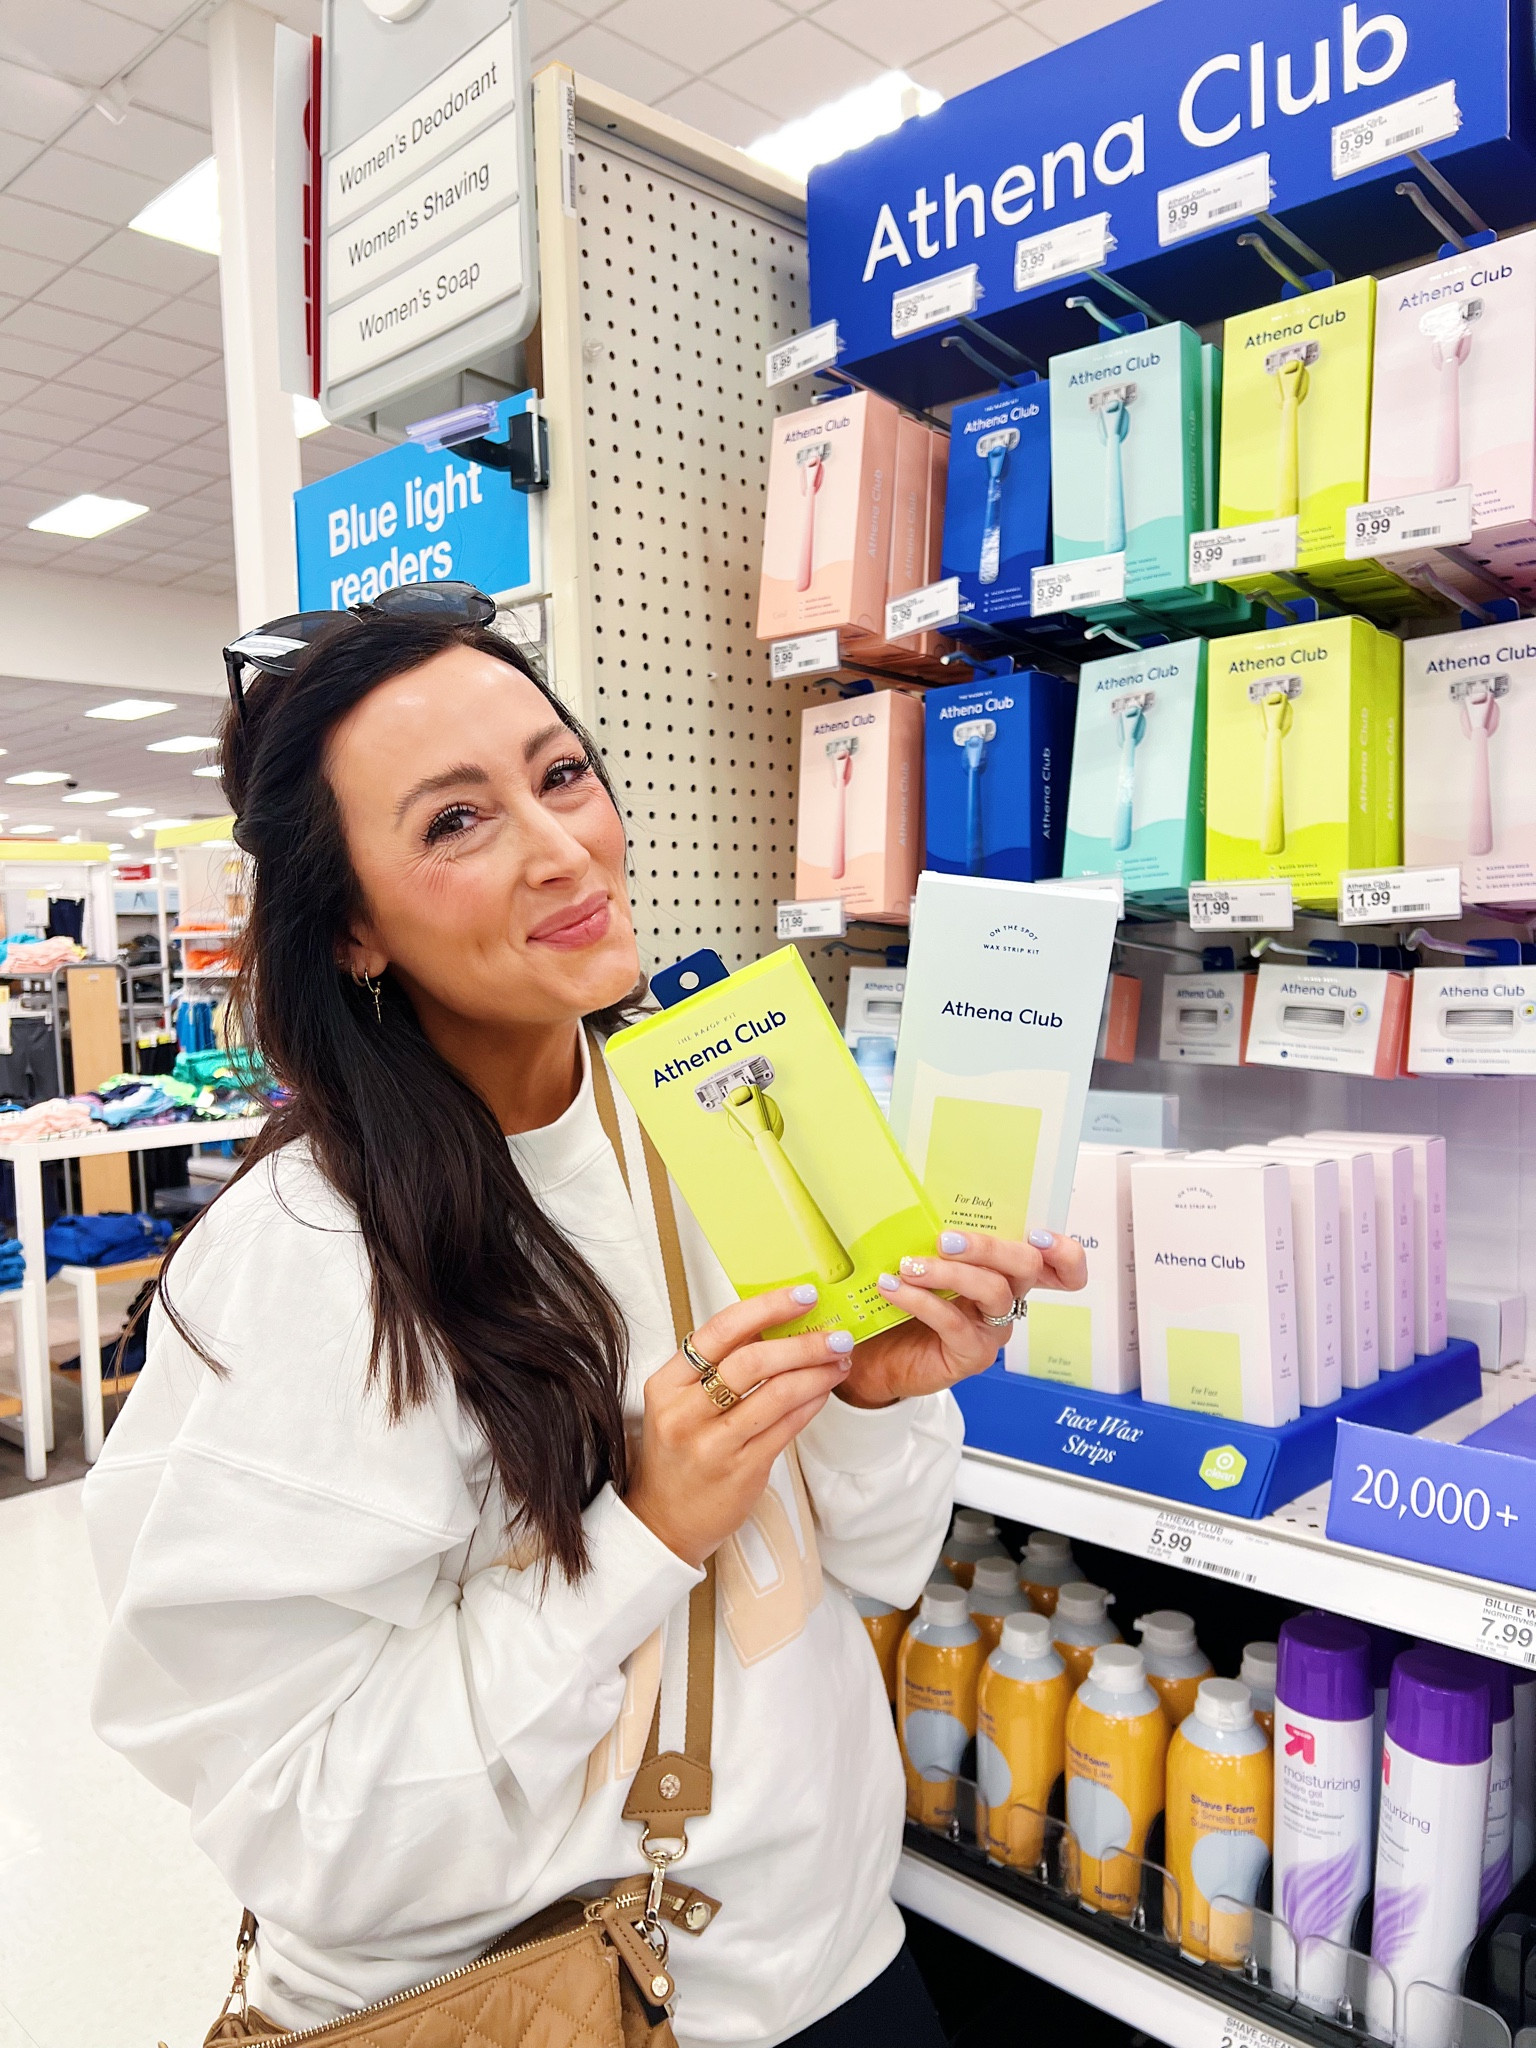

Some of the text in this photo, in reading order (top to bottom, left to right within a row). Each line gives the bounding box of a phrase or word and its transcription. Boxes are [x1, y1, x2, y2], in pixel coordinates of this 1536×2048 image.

[339, 133, 407, 194] Women's
[412, 61, 498, 144] Deodorant
[862, 2, 1408, 283] Athena Club
[1339, 130, 1374, 154] 9.99
[348, 162, 490, 268] Women's Shaving
[1168, 202, 1198, 224] 9.99
[358, 261, 480, 342] Women's Soap
[1399, 265, 1513, 311] Athena Club
[1244, 321, 1303, 349] Athena
[1308, 309, 1346, 331] Club
[1068, 365, 1122, 388] Athena
[1126, 352, 1161, 373] Club
[784, 417, 850, 444] Athena Club
[963, 413, 1009, 435] Athena
[1009, 403, 1040, 421] Club
[328, 461, 483, 558] Blue light
[868, 468, 884, 558] Athena Club
[1356, 518, 1391, 537] 9.99
[1193, 546, 1223, 564] 9.99
[330, 540, 453, 611] readers
[1037, 585, 1063, 601] 9.99
[1228, 647, 1329, 675] Athena Club
[1426, 644, 1536, 674] Athena Club
[1095, 664, 1180, 692] Athena Club
[939, 695, 1014, 720] Athena Club
[813, 713, 876, 735] Athena Club
[1360, 707, 1369, 814] Athena Club
[1041, 747, 1052, 840] Athena Club
[1193, 901, 1230, 916] 11.99
[1347, 891, 1391, 908] 11.99
[781, 916, 803, 929] 11.99
[989, 927, 1001, 937] ON
[1020, 927, 1038, 941] SPOT
[1176, 987, 1225, 999] Athena Club
[1280, 983, 1357, 998] Athena Club
[1439, 983, 1525, 998] Athena Club
[941, 1000, 1063, 1028] Athena Club
[654, 1038, 732, 1088] Athena
[734, 1011, 787, 1043] Club
[955, 1194, 994, 1209] For Body
[1154, 1252, 1246, 1270] Athena Club
[858, 1282, 877, 1294] RAZO
[1055, 1406, 1144, 1443] Face Wax
[1061, 1434, 1117, 1466] Strips
[1204, 1467, 1236, 1483] clean
[1352, 1463, 1519, 1532] 20,000+
[1157, 1512, 1225, 1536] ATHENA CLUB
[1150, 1528, 1192, 1552] 5.99
[1484, 1597, 1524, 1616] BILLIE
[1481, 1616, 1533, 1648] 7.99
[1284, 1764, 1361, 1793] moisturizing
[1190, 1793, 1255, 1814] Shave Foam
[1308, 1789, 1323, 1800] gel
[1226, 2017, 1258, 2038] SHAVE
[1260, 2033, 1292, 2048] CREA
